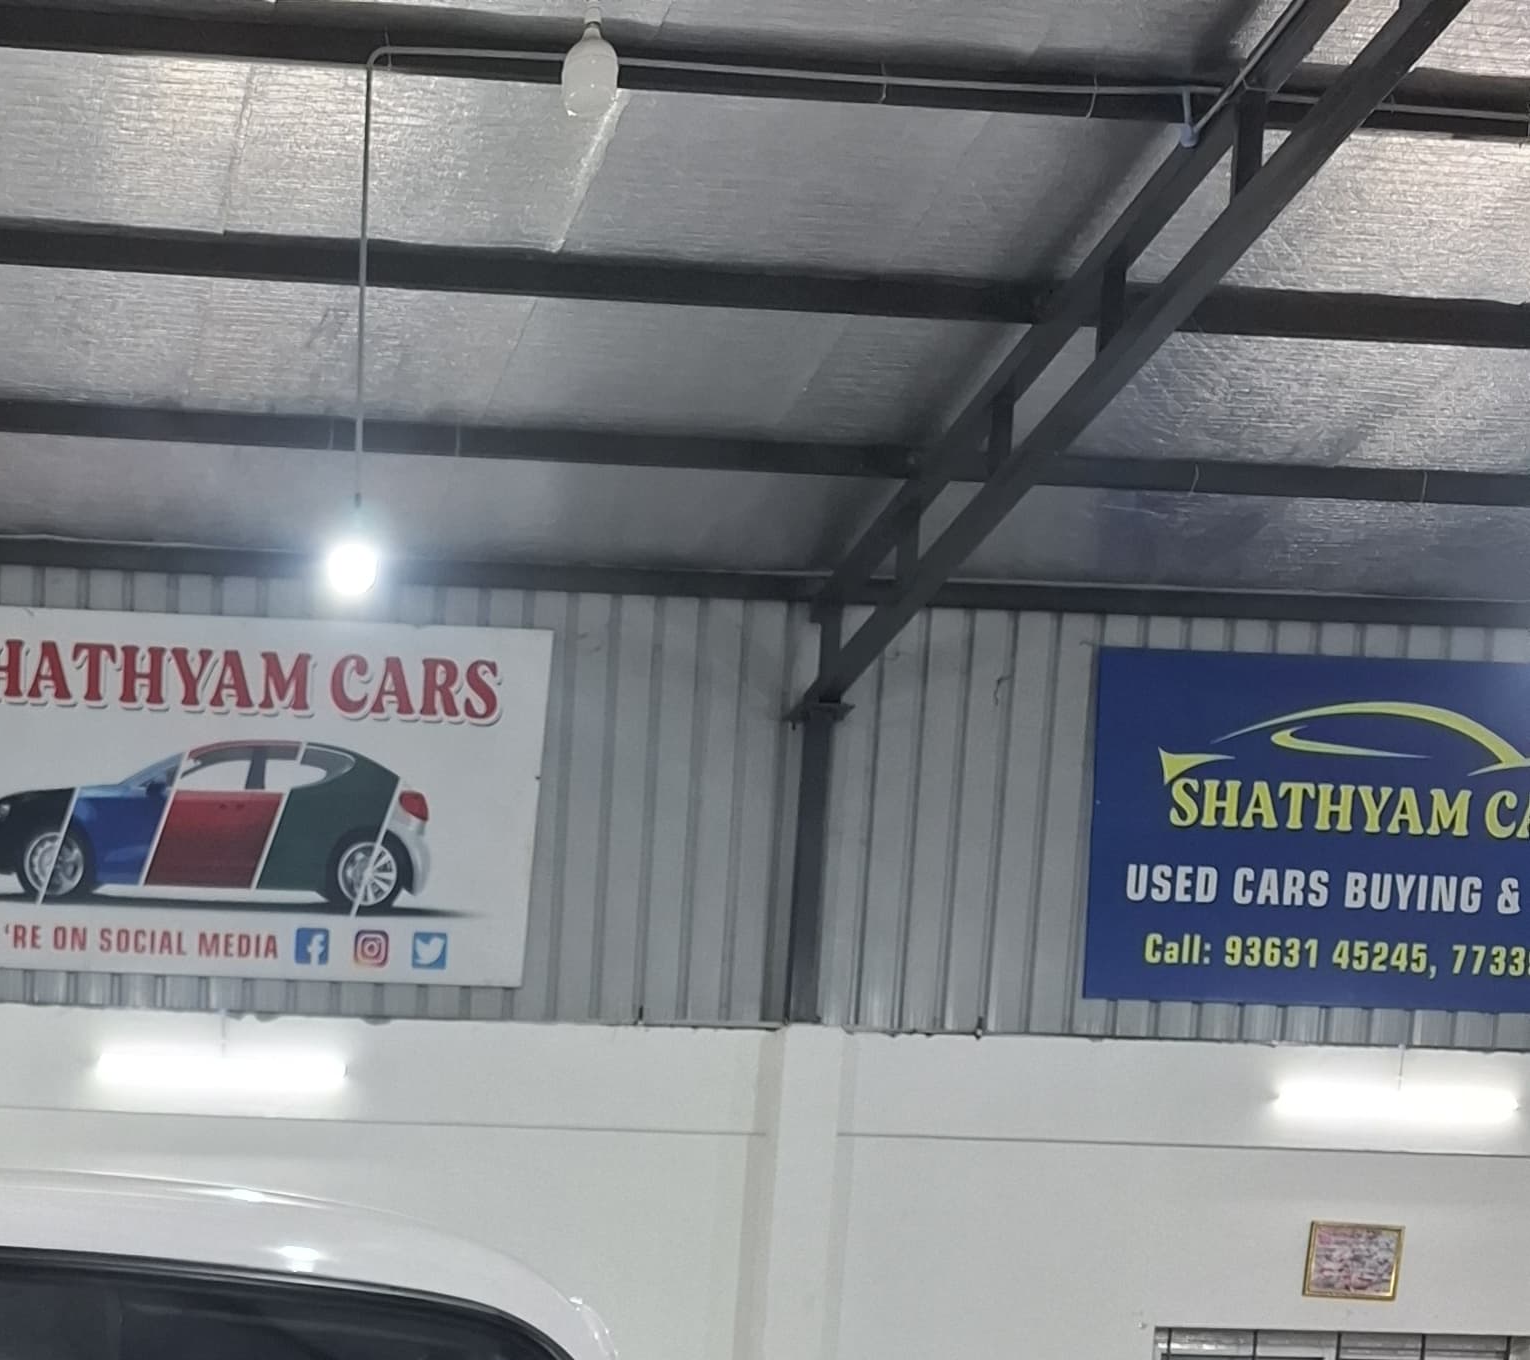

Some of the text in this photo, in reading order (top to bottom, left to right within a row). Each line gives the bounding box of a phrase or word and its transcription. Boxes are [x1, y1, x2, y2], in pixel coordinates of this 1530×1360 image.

[330, 654, 502, 724] CARS
[1170, 777, 1473, 838] SHATHYAM
[1126, 863, 1522, 916] USED CARS BUYING &
[53, 926, 88, 951] ON
[99, 927, 188, 956] SOCIAL
[198, 931, 279, 959] MEDIA
[1144, 932, 1530, 980] Call: 93631 45245, 7733
